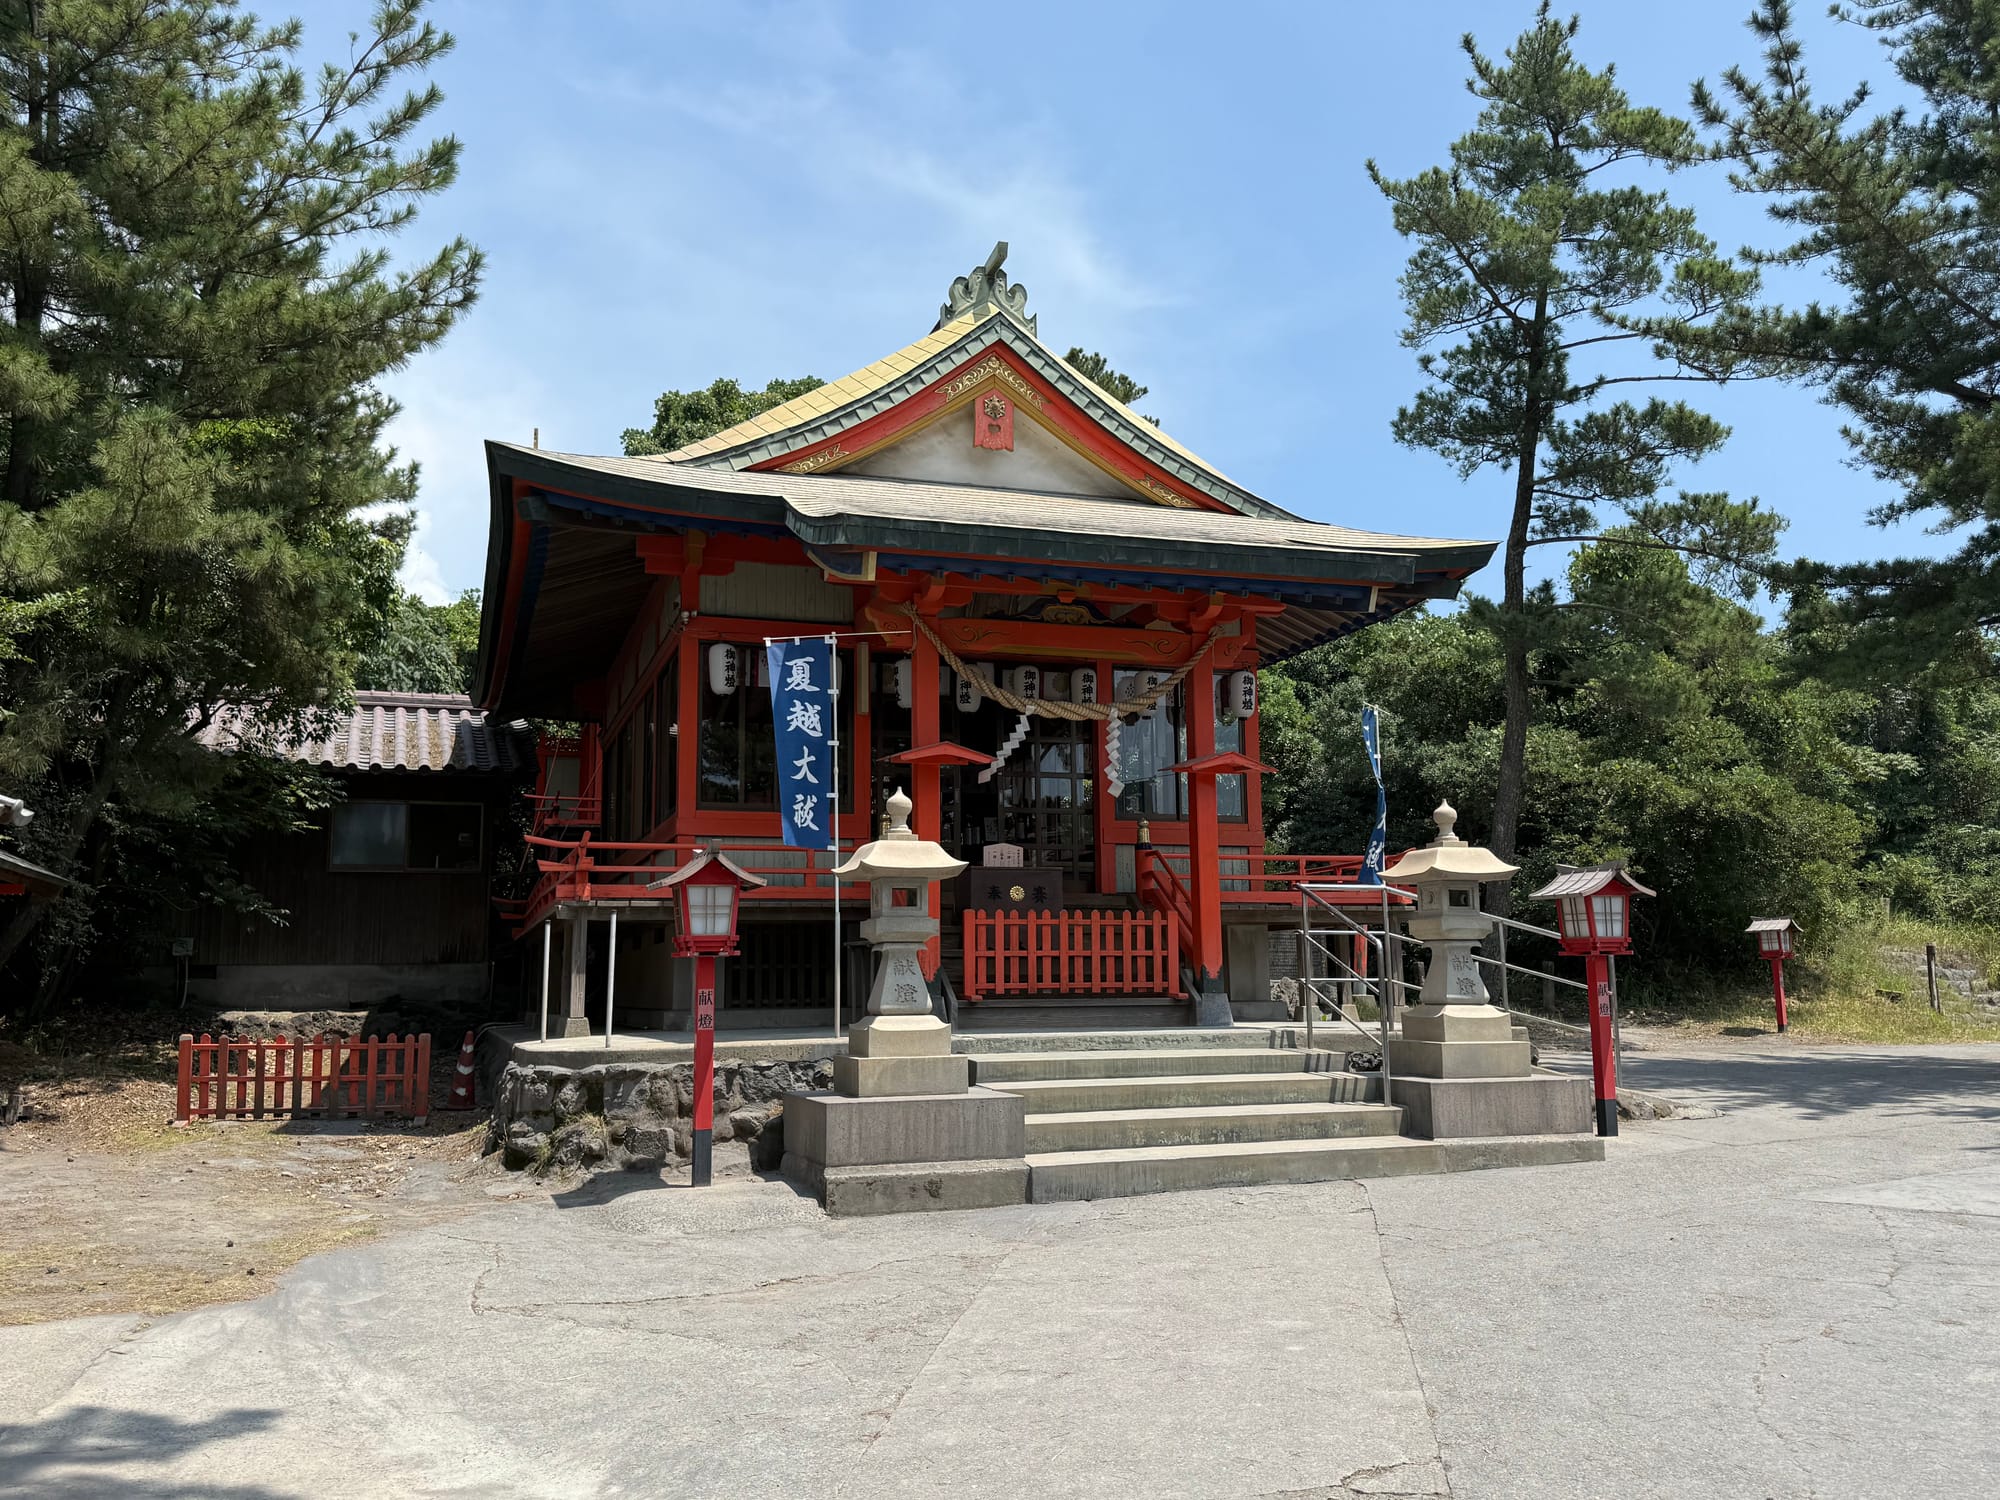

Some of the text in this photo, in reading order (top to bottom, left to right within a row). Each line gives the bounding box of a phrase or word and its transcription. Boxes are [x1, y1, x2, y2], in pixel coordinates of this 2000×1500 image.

[724, 648, 736, 687] 御神燈
[1242, 674, 1254, 710] 御神燈
[785, 657, 824, 831] 夏越大祓
[894, 959, 918, 1003] 献燈
[698, 990, 713, 1029] 献燈
